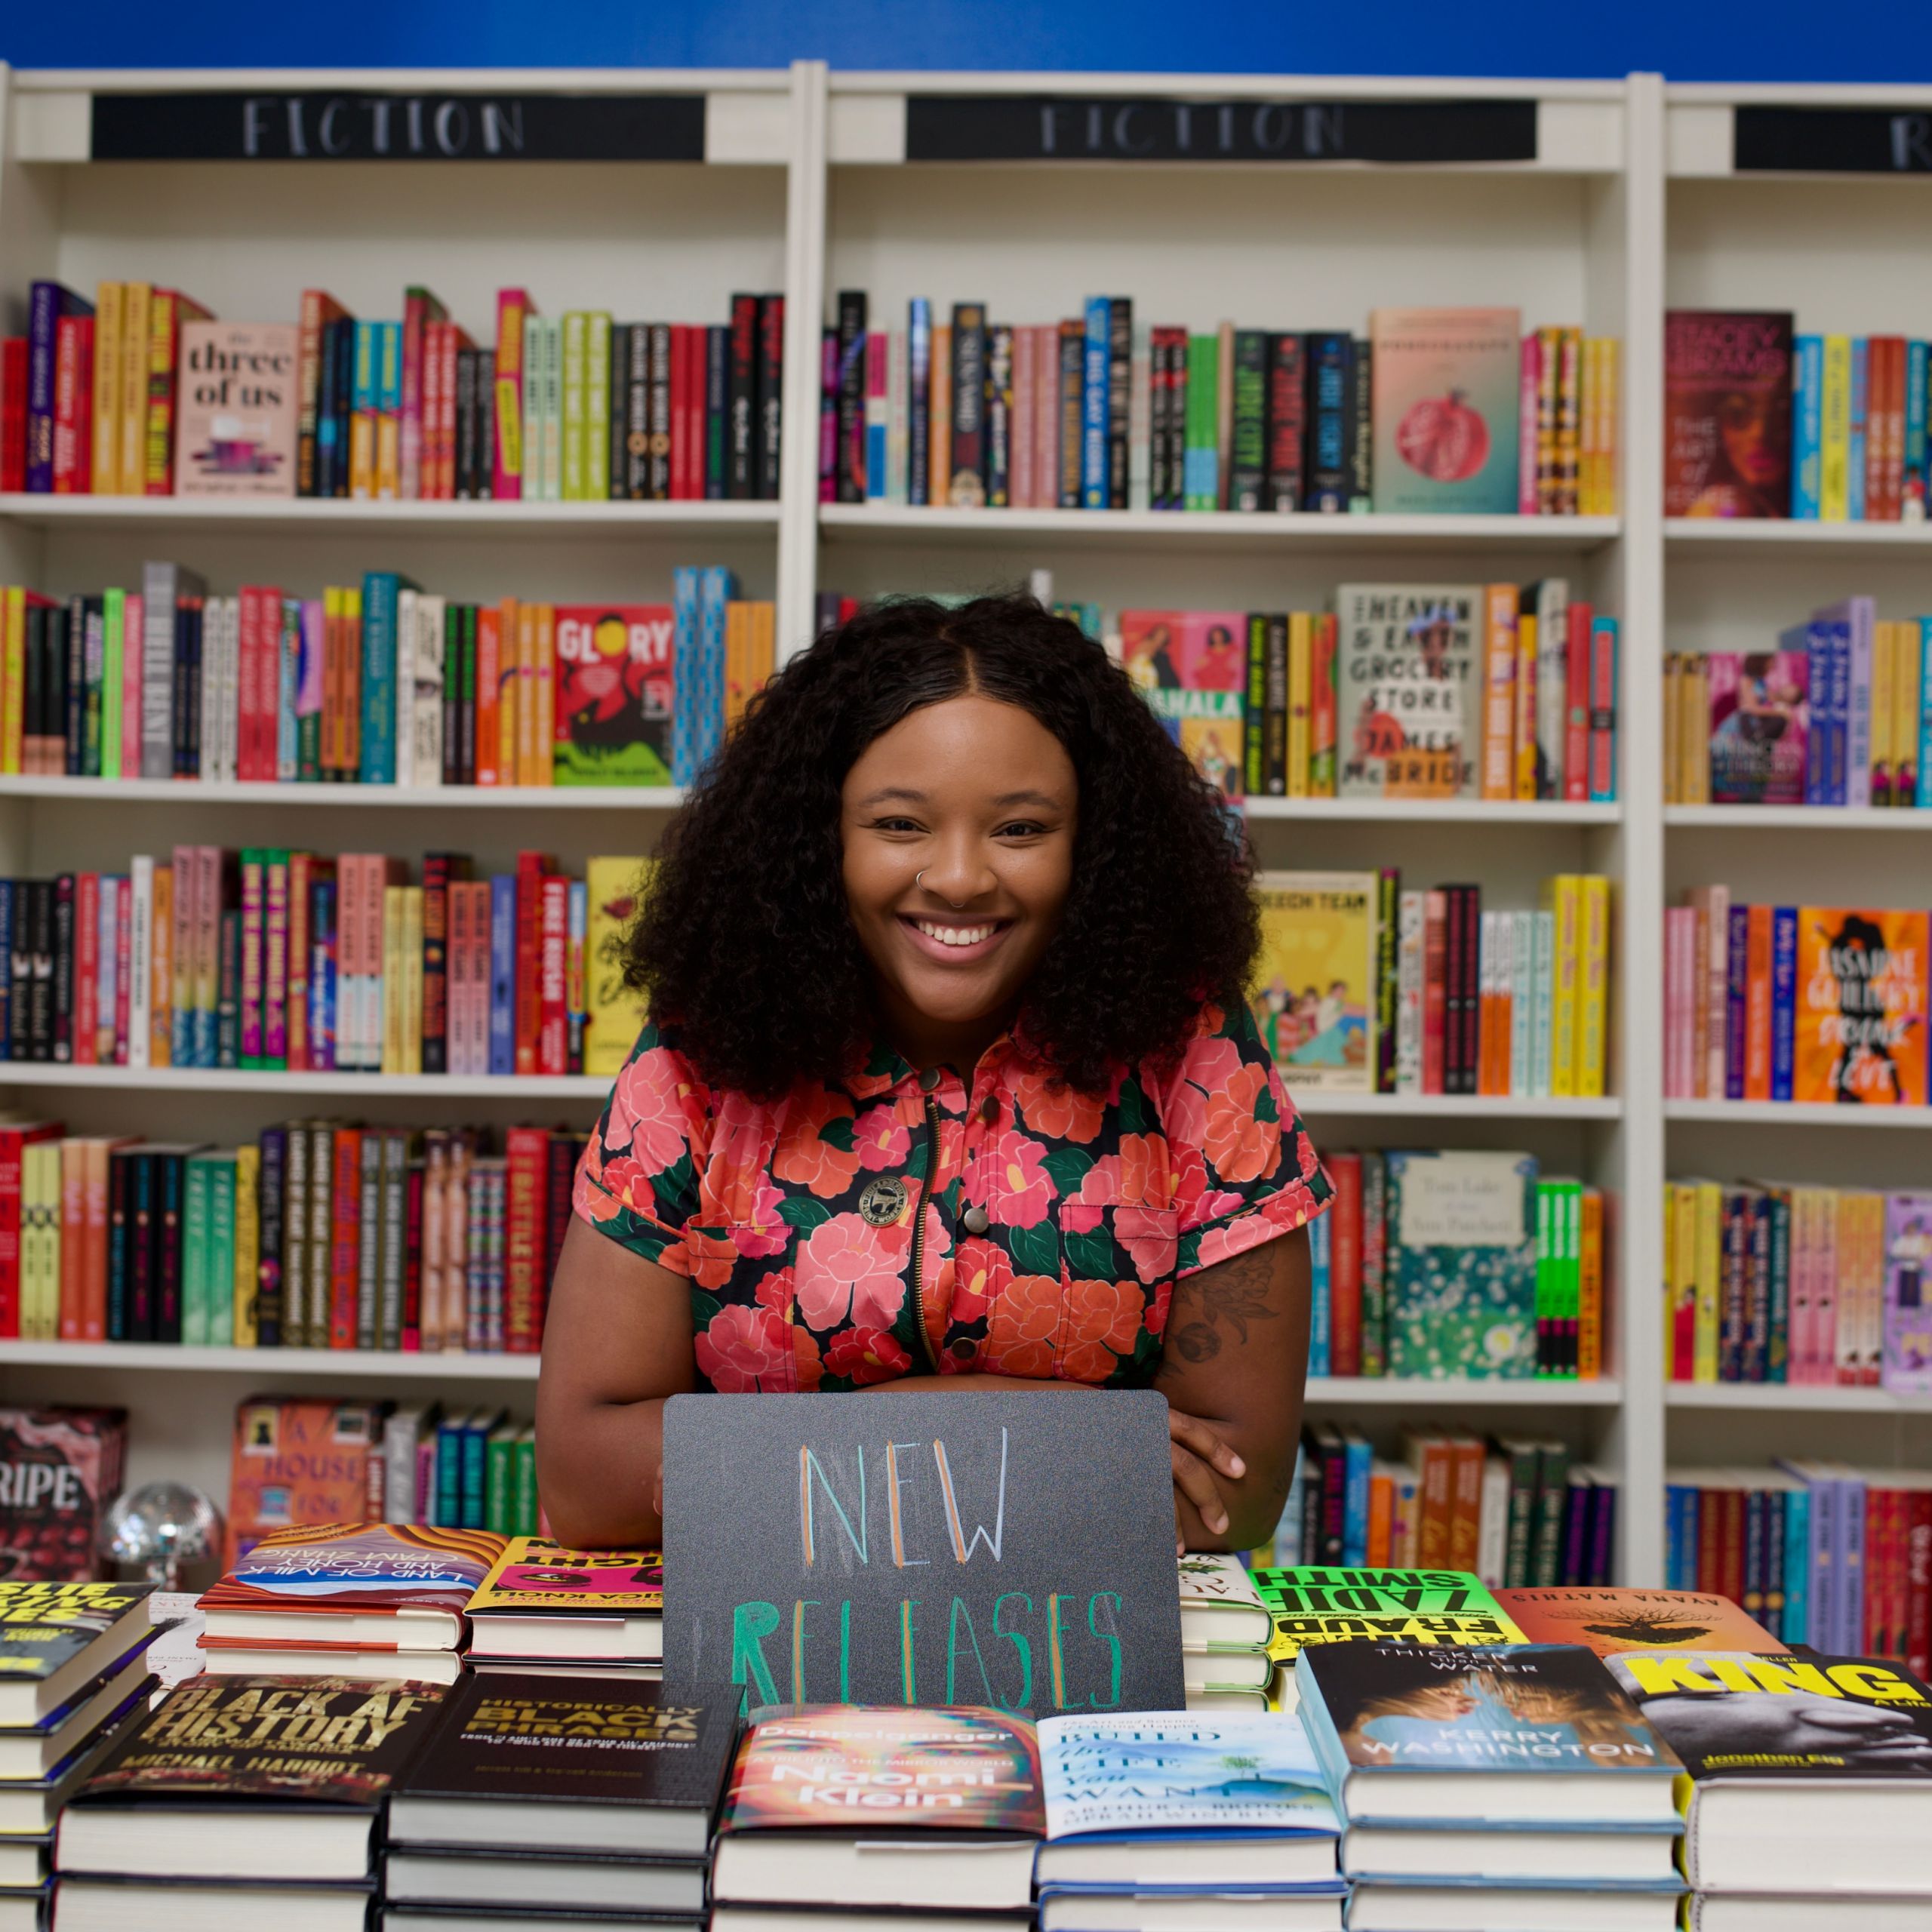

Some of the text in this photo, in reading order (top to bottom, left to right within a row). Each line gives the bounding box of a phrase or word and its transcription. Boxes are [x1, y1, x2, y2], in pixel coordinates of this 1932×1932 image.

[242, 99, 524, 155] FICTION
[1040, 104, 1345, 155] FICTION
[188, 342, 292, 374] three
[195, 375, 282, 407] of us
[557, 617, 674, 665] GLORY
[1368, 687, 1453, 712] STORE
[1366, 731, 1454, 755] JAMES
[1423, 1177, 1502, 1195] Tom Lake
[265, 1452, 358, 1482] HOUSE
[0, 1461, 82, 1509] RIPE
[799, 1426, 1008, 1570] NEW
[262, 1549, 460, 1562] C PAM ZHANG
[276, 1557, 448, 1571] AND HONEY
[515, 1555, 663, 1567] IGHT
[244, 1565, 463, 1582] LAND OF MILK
[1253, 1571, 1466, 1588] SMITH
[1261, 1587, 1488, 1614] ZADIE
[1509, 1593, 1719, 1607] AYANA MATHIS
[1276, 1617, 1503, 1635] FRAUD
[732, 1591, 1123, 1718] RELEASES
[1375, 1648, 1509, 1661] THICKER
[1430, 1662, 1539, 1673] WATER
[1623, 1657, 1927, 1702] KING
[157, 1687, 426, 1721] BLACK AF
[479, 1698, 705, 1716] HISTORICALLY
[1873, 1698, 1932, 1709] A Life
[471, 1707, 699, 1730] BLACK
[139, 1710, 408, 1749] HISTORY
[463, 1721, 699, 1741] PHRASES
[758, 1726, 1014, 1743] Doppelganger
[1060, 1731, 1221, 1743] BUILD
[1438, 1729, 1563, 1744] KERRY
[1060, 1746, 1112, 1759] the
[1361, 1741, 1655, 1758] WASHINGTON
[119, 1753, 367, 1774] MICHAEL HARRIOT
[953, 1758, 1014, 1767] WORLD
[1063, 1757, 1182, 1772] LIFE
[1702, 1753, 1805, 1767] Jonathan
[1807, 1755, 1845, 1767] Eig
[771, 1764, 995, 1786] Naomi
[798, 1786, 964, 1808] Klein
[1063, 1786, 1232, 1802] WANT
